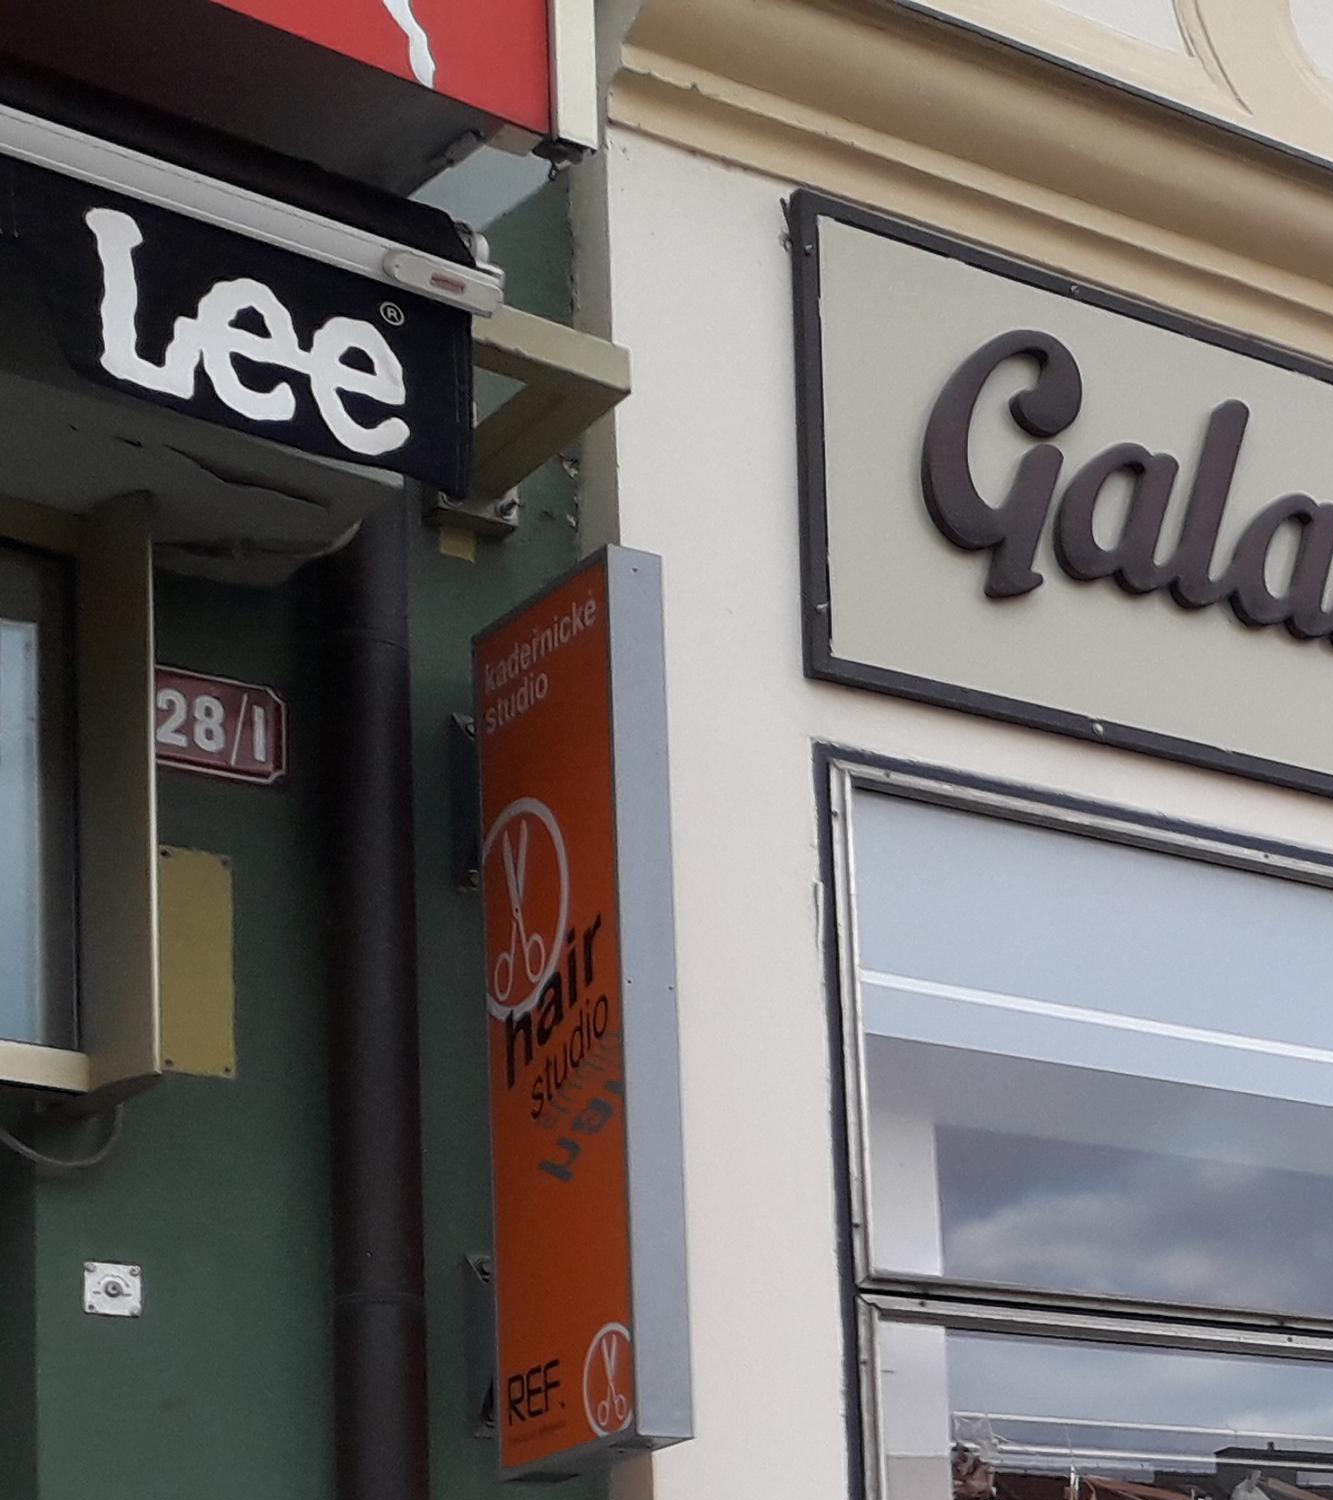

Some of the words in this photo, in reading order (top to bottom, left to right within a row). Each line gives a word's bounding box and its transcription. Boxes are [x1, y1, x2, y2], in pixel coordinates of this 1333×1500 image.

[84, 207, 410, 455] Lee
[483, 671, 548, 735] studio
[505, 912, 602, 1089] hair
[531, 993, 609, 1120] studio
